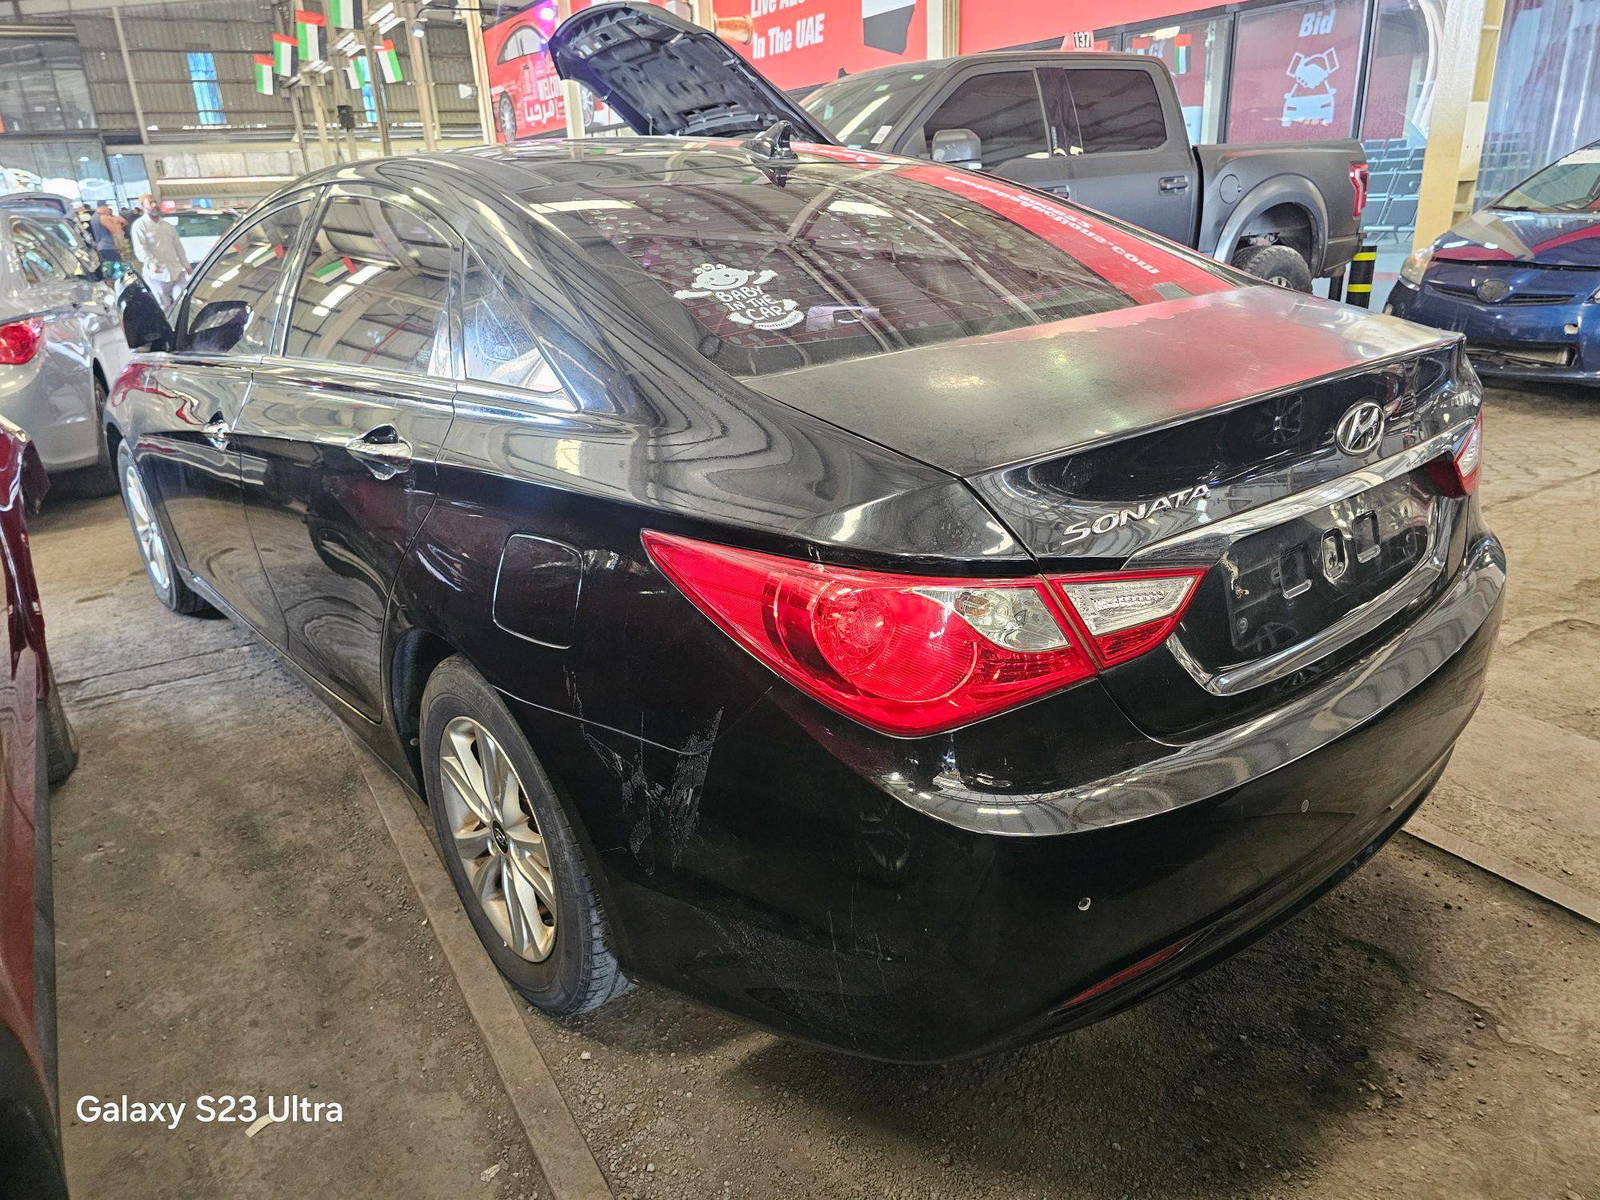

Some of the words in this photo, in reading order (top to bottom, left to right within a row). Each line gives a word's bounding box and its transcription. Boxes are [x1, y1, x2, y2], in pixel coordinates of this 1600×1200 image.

[1298, 8, 1336, 38] Bid
[752, 32, 766, 60] In
[768, 26, 793, 56] The
[796, 13, 825, 49] UAE
[1073, 31, 1091, 48] 137
[715, 285, 764, 303] BABY
[722, 302, 746, 312] IN
[746, 294, 780, 308] THE
[745, 305, 787, 320] CAR
[1061, 484, 1211, 546] SONATA
